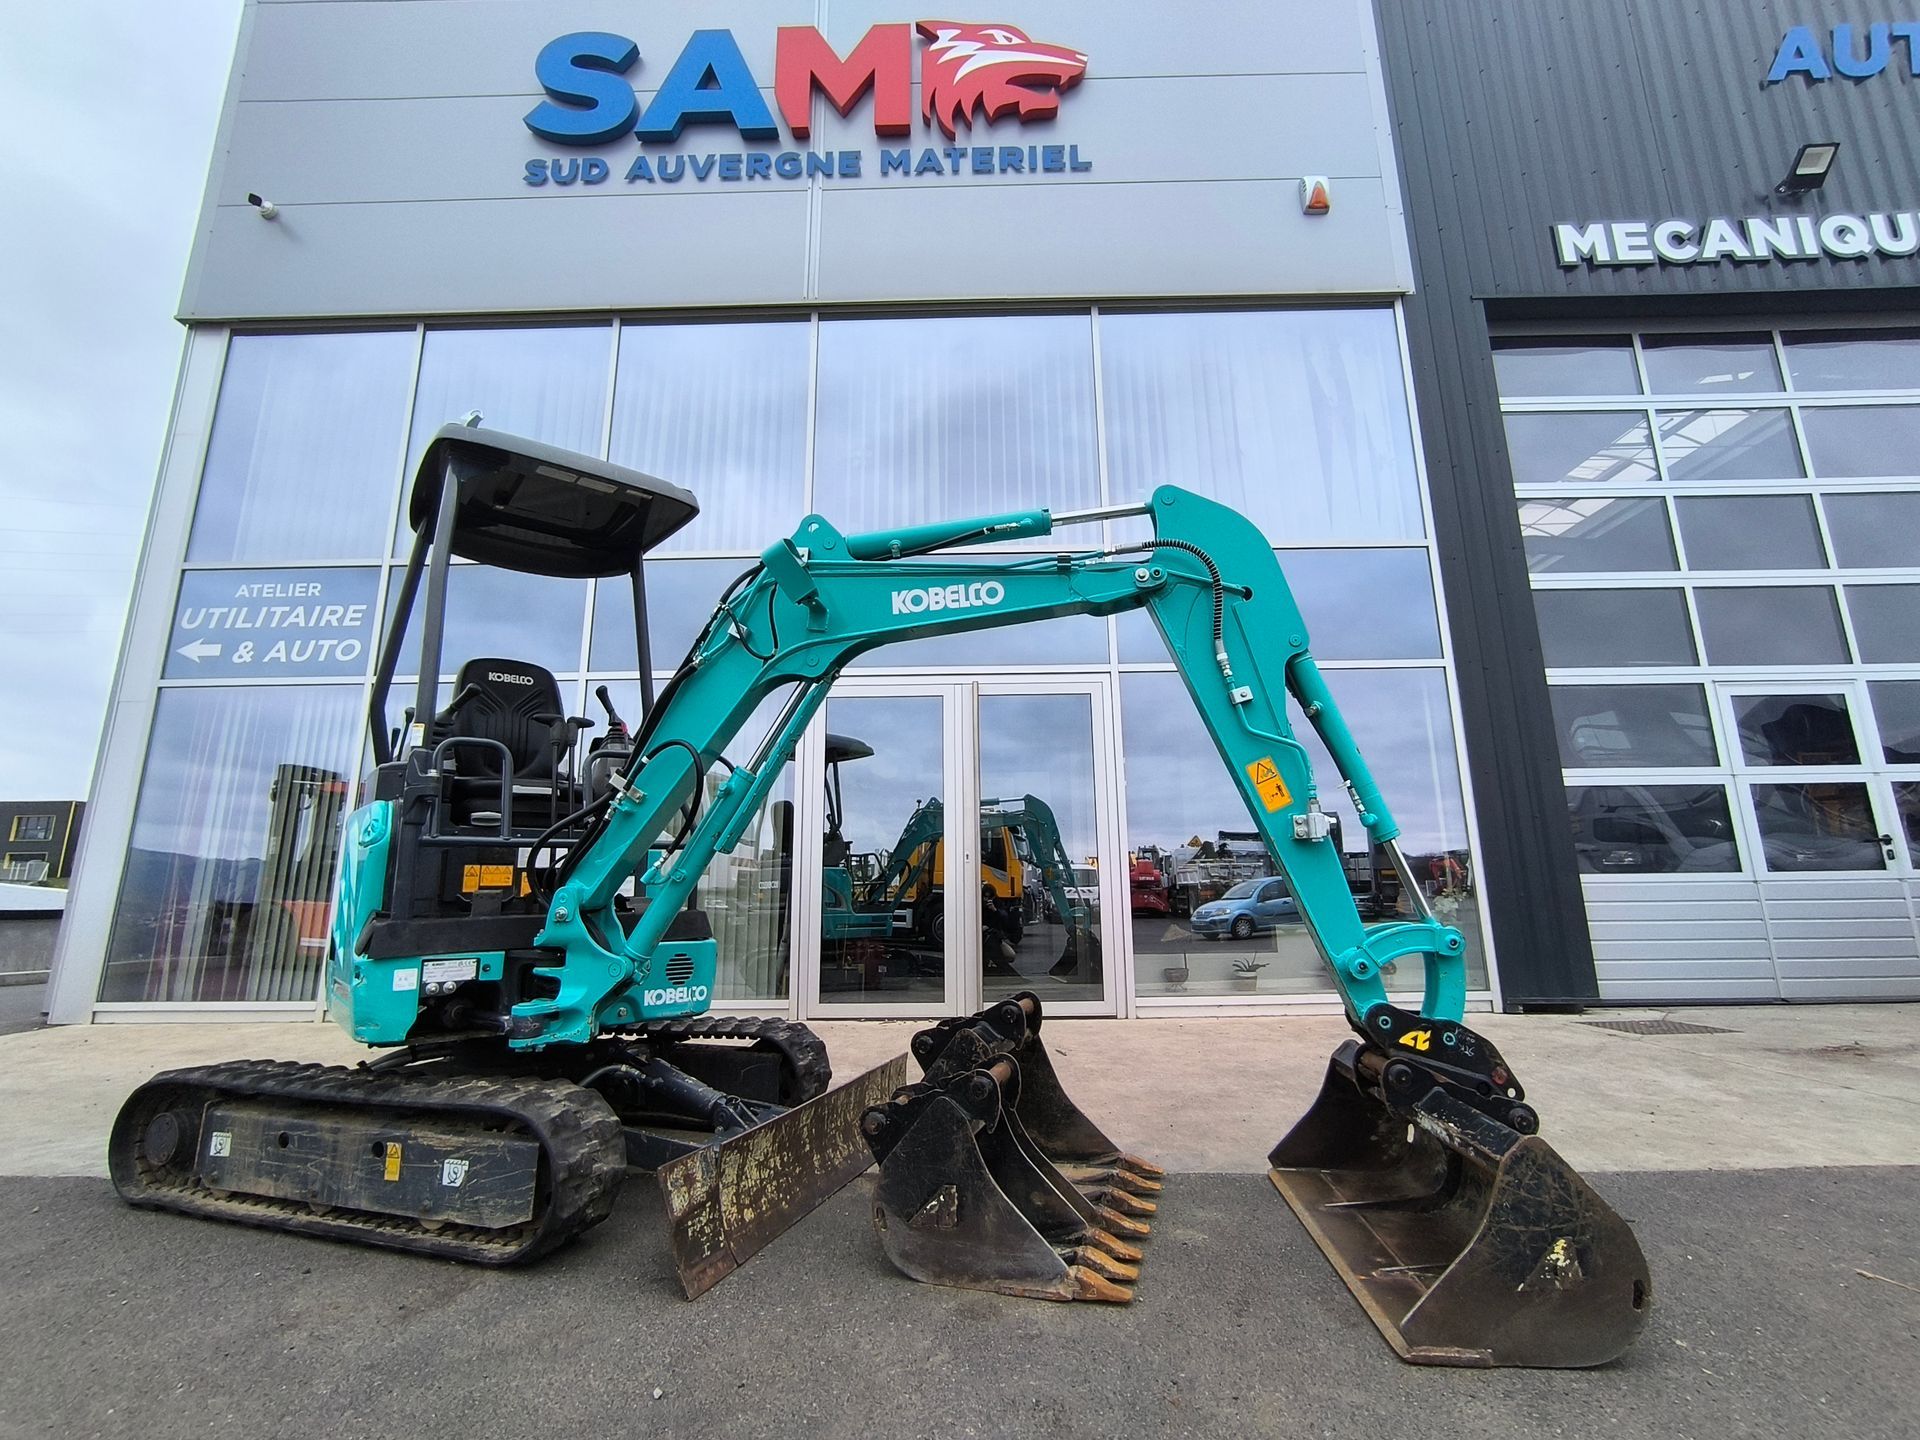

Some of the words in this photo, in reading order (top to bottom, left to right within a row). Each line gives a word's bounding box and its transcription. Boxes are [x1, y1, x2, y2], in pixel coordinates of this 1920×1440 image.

[523, 23, 911, 144] SAM
[524, 156, 608, 184] SUD
[625, 150, 862, 182] AUVERGNE
[880, 144, 1093, 174] MATERIEL
[1553, 212, 1920, 265] MECANIQU
[235, 583, 322, 598] ATELIER
[891, 580, 1005, 615] KOBELCO
[180, 604, 368, 630] UTILITAIRE
[232, 641, 254, 664] &
[262, 639, 362, 663] AUTO
[488, 671, 535, 686] KOBELCO
[643, 985, 708, 1007] KOBELCO
